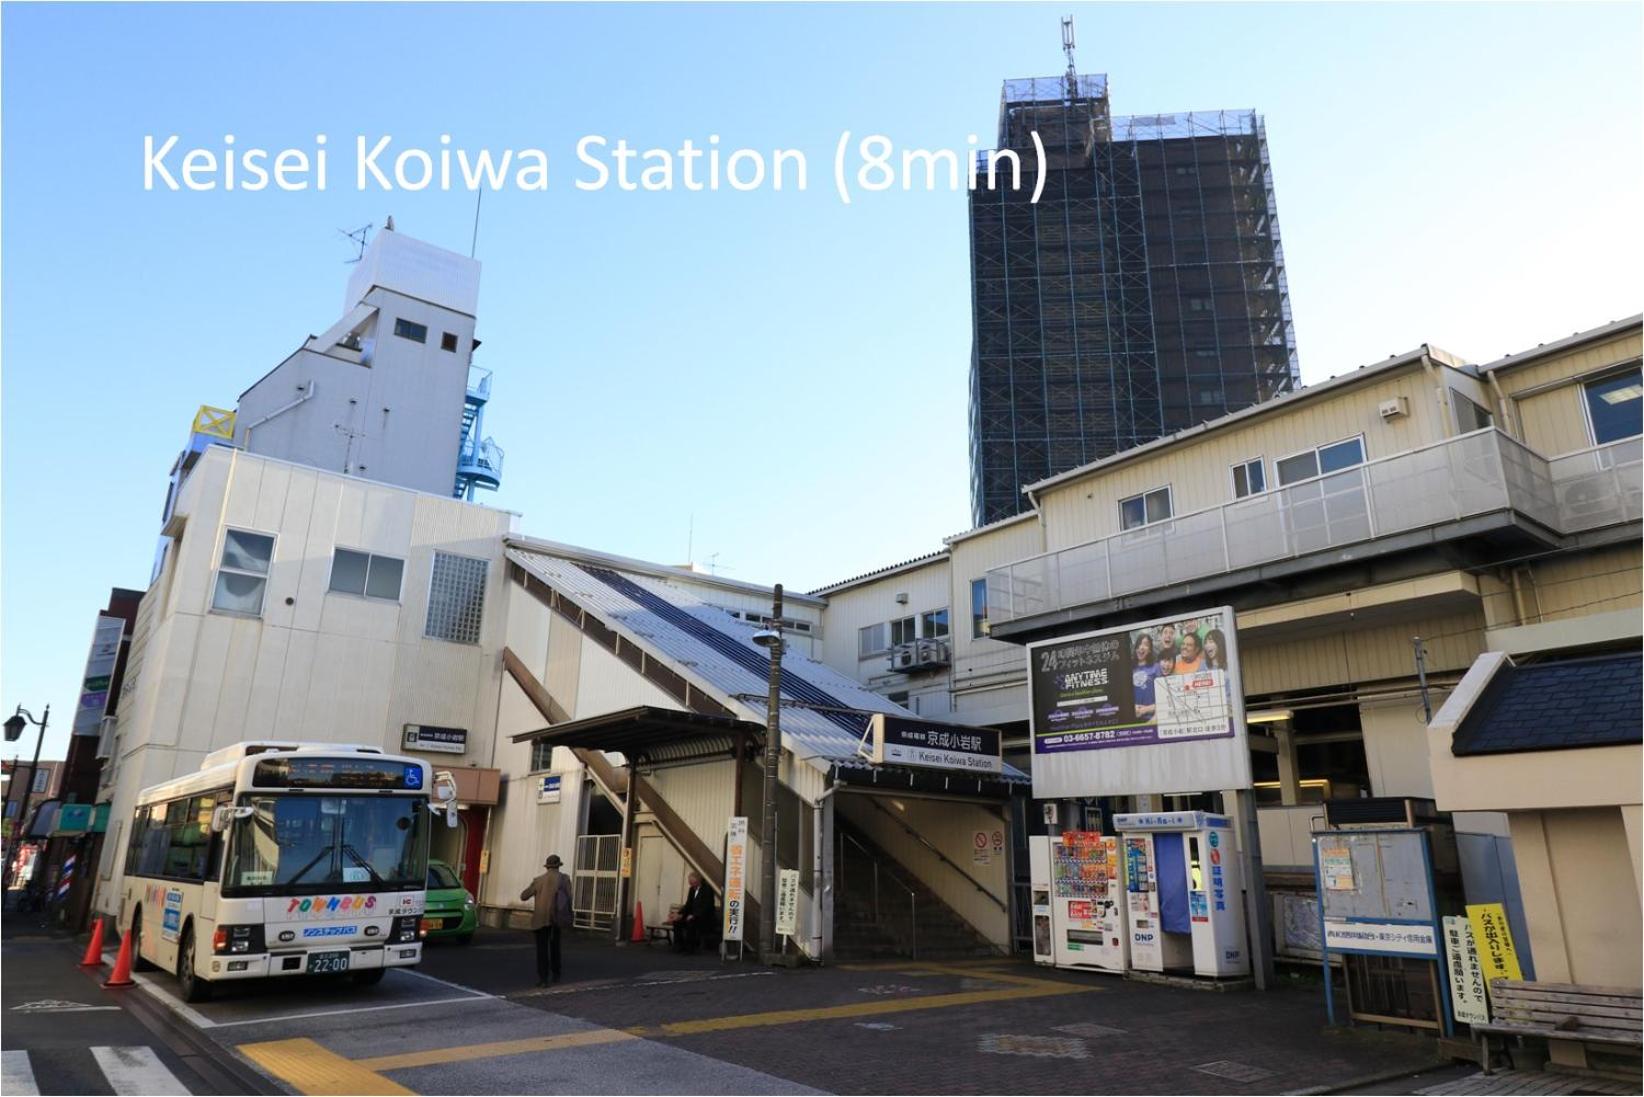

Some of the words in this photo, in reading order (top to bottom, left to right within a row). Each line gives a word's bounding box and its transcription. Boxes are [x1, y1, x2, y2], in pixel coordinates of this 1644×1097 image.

[927, 730, 982, 752] 京成小岩駅
[919, 750, 943, 763] Keisei
[943, 753, 967, 766] Koiwa
[967, 756, 993, 769] Station
[1134, 932, 1154, 942] DNP
